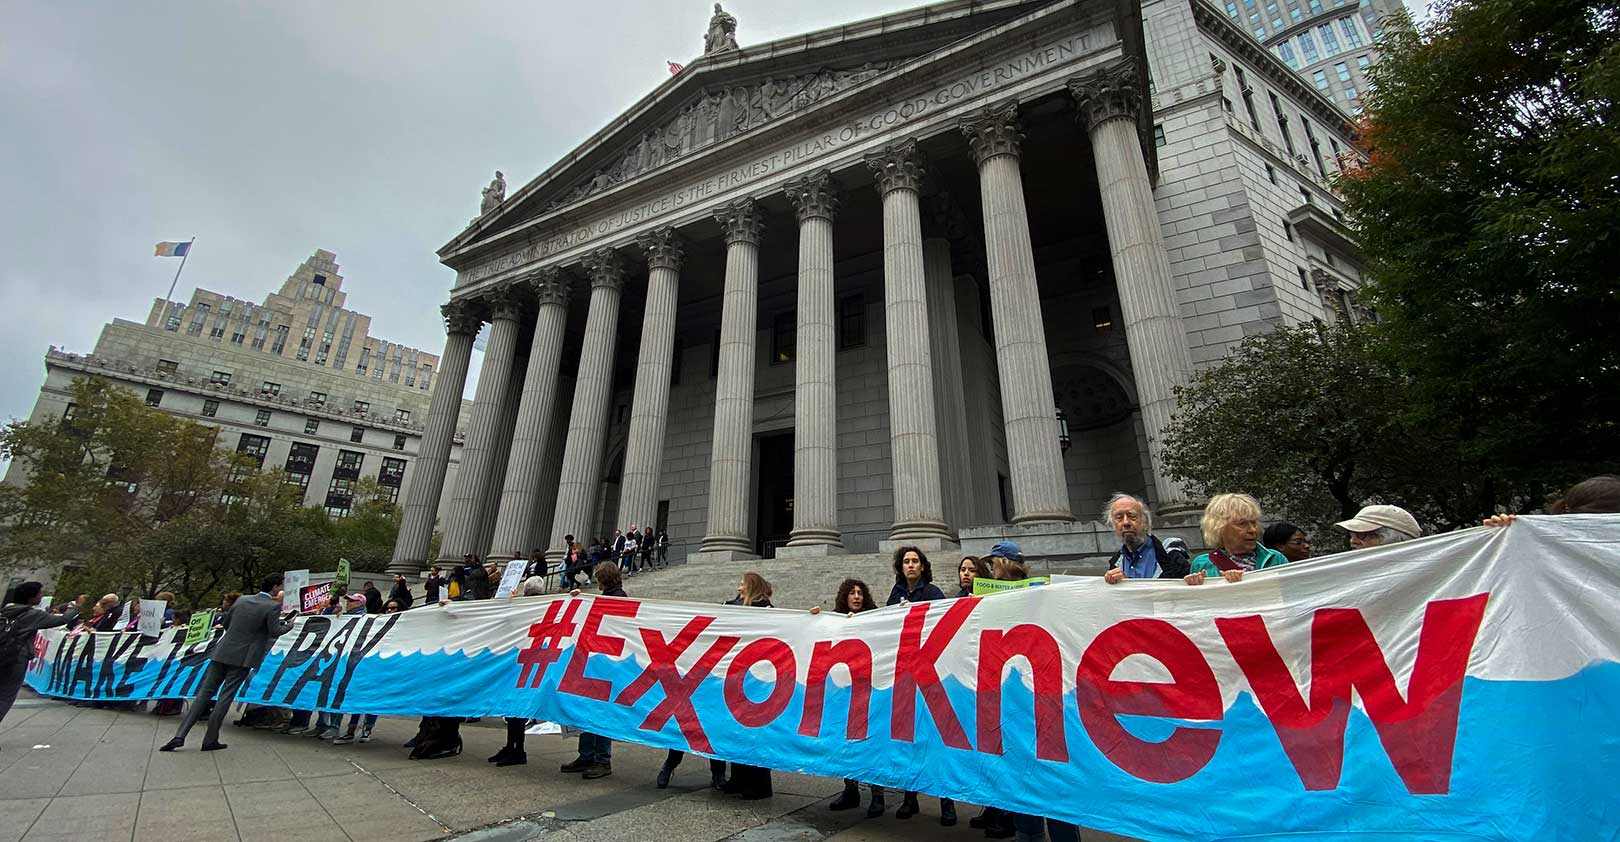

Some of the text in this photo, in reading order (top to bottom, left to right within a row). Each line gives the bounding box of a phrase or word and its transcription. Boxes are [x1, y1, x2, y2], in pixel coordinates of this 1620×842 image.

[464, 34, 1090, 282] THE TRUE ADMINISTRATION OF JUSTICE IS THE FIRMEST PILLAR OF GOOD GOVERNMENT
[304, 583, 331, 601] CLIMATE
[304, 593, 332, 609] EMERGE
[46, 631, 160, 698] MAKE
[263, 613, 402, 709] PAY
[516, 592, 1490, 795] #ExxonKnew
